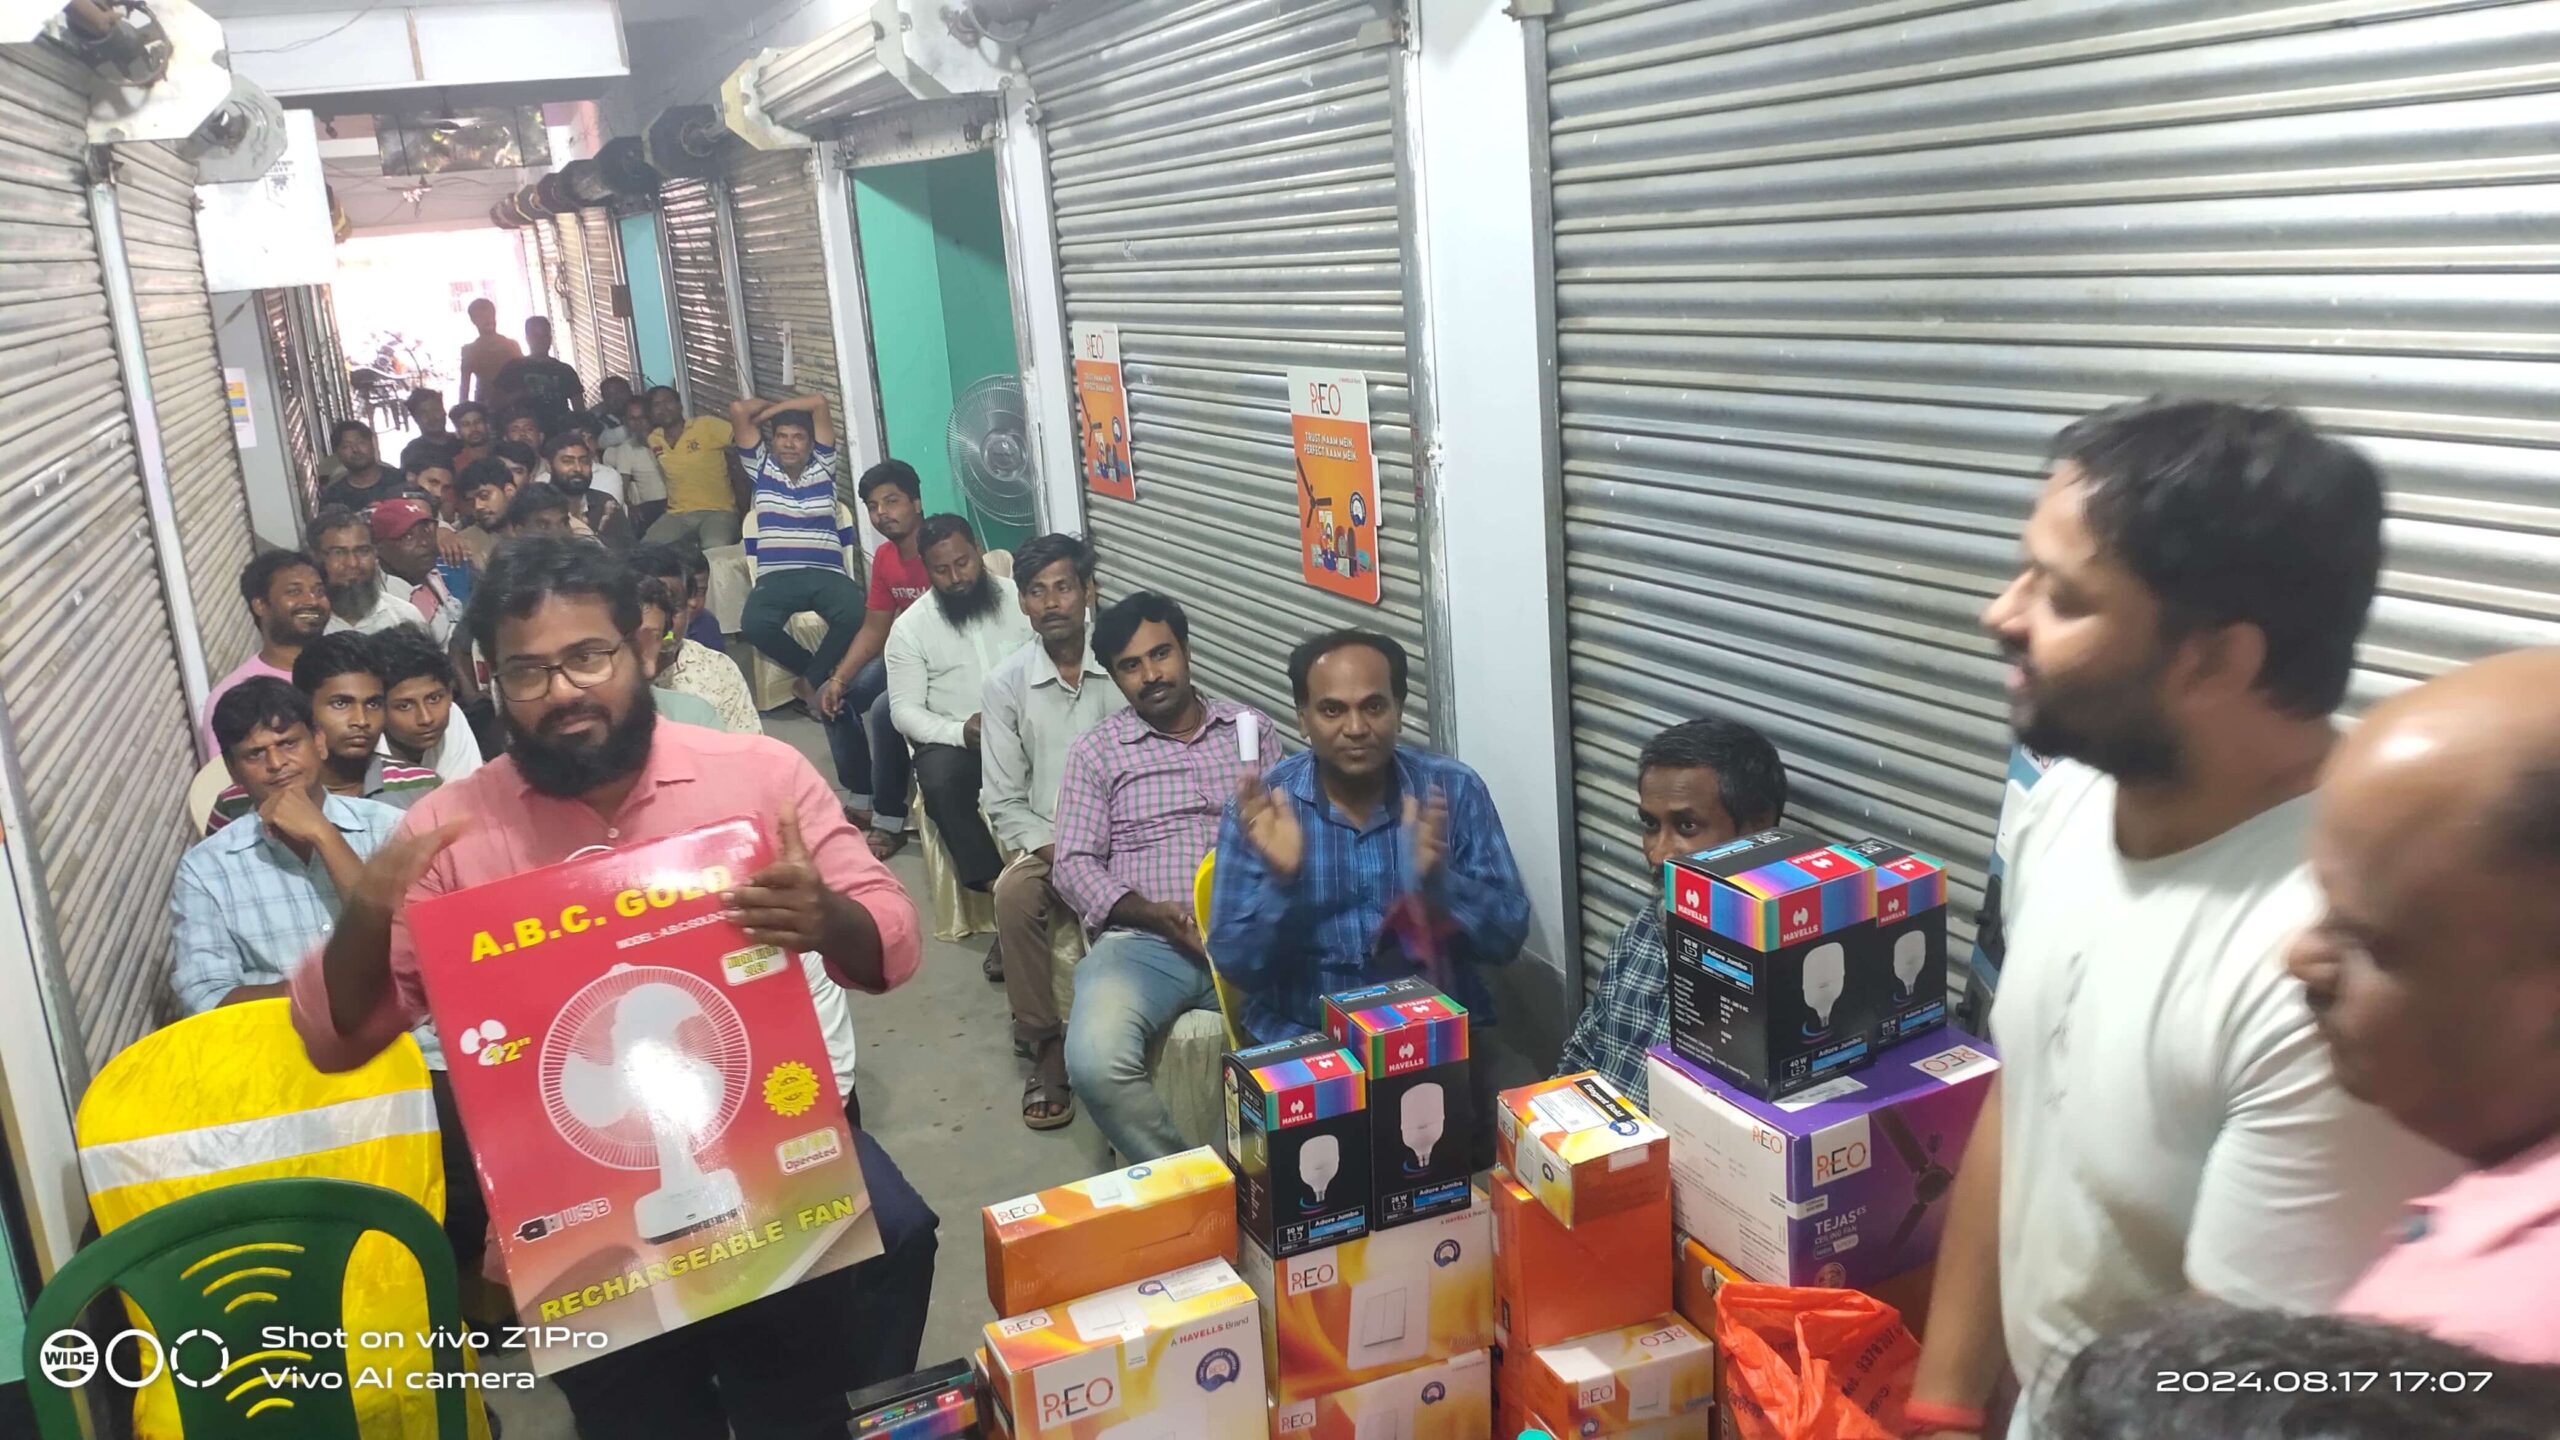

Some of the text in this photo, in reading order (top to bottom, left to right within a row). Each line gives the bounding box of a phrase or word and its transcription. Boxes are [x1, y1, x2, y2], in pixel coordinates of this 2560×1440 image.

[1309, 382, 1342, 416] REO
[1791, 850, 1832, 865] HAVELLS
[471, 865, 733, 962] A.B.C. GOLD
[1677, 903, 1709, 924] HAVELLS
[1880, 910, 1906, 924] HAVELLS
[1783, 923, 1819, 942] HAVELLS
[1818, 1036, 1863, 1058] Adore Jumbo
[1388, 1058, 1424, 1072] HAVELLS
[1789, 1060, 1800, 1069] 40
[1799, 1056, 1808, 1066] W
[1923, 1047, 1980, 1073] REO
[1790, 1066, 1807, 1077] LED
[1584, 1083, 1611, 1110] Elegant
[1608, 1101, 1626, 1118] Bold
[1282, 1112, 1313, 1125] HAVELLS
[1752, 1125, 1783, 1154] REO
[784, 1145, 838, 1171] Operated
[1816, 1142, 1867, 1181] REO
[1419, 1180, 1463, 1195] Adore Jumbo
[563, 1197, 612, 1227] USB
[997, 1203, 1040, 1224] REO
[1392, 1201, 1408, 1211] LED
[1314, 1210, 1359, 1227] Adore Jumbo
[1814, 1210, 1857, 1235] TEJAS
[1287, 1232, 1303, 1242] LED
[540, 1196, 857, 1323] RECHARGEABLE FAN
[1291, 1263, 1334, 1292] REO
[1004, 1315, 1048, 1336] REO
[1171, 1316, 1249, 1347] A HAVELLS Brand
[1640, 1326, 1688, 1348] REO
[1043, 1377, 1114, 1424] REO
[1581, 1385, 1613, 1406] REO
[1281, 1411, 1314, 1432] REO
